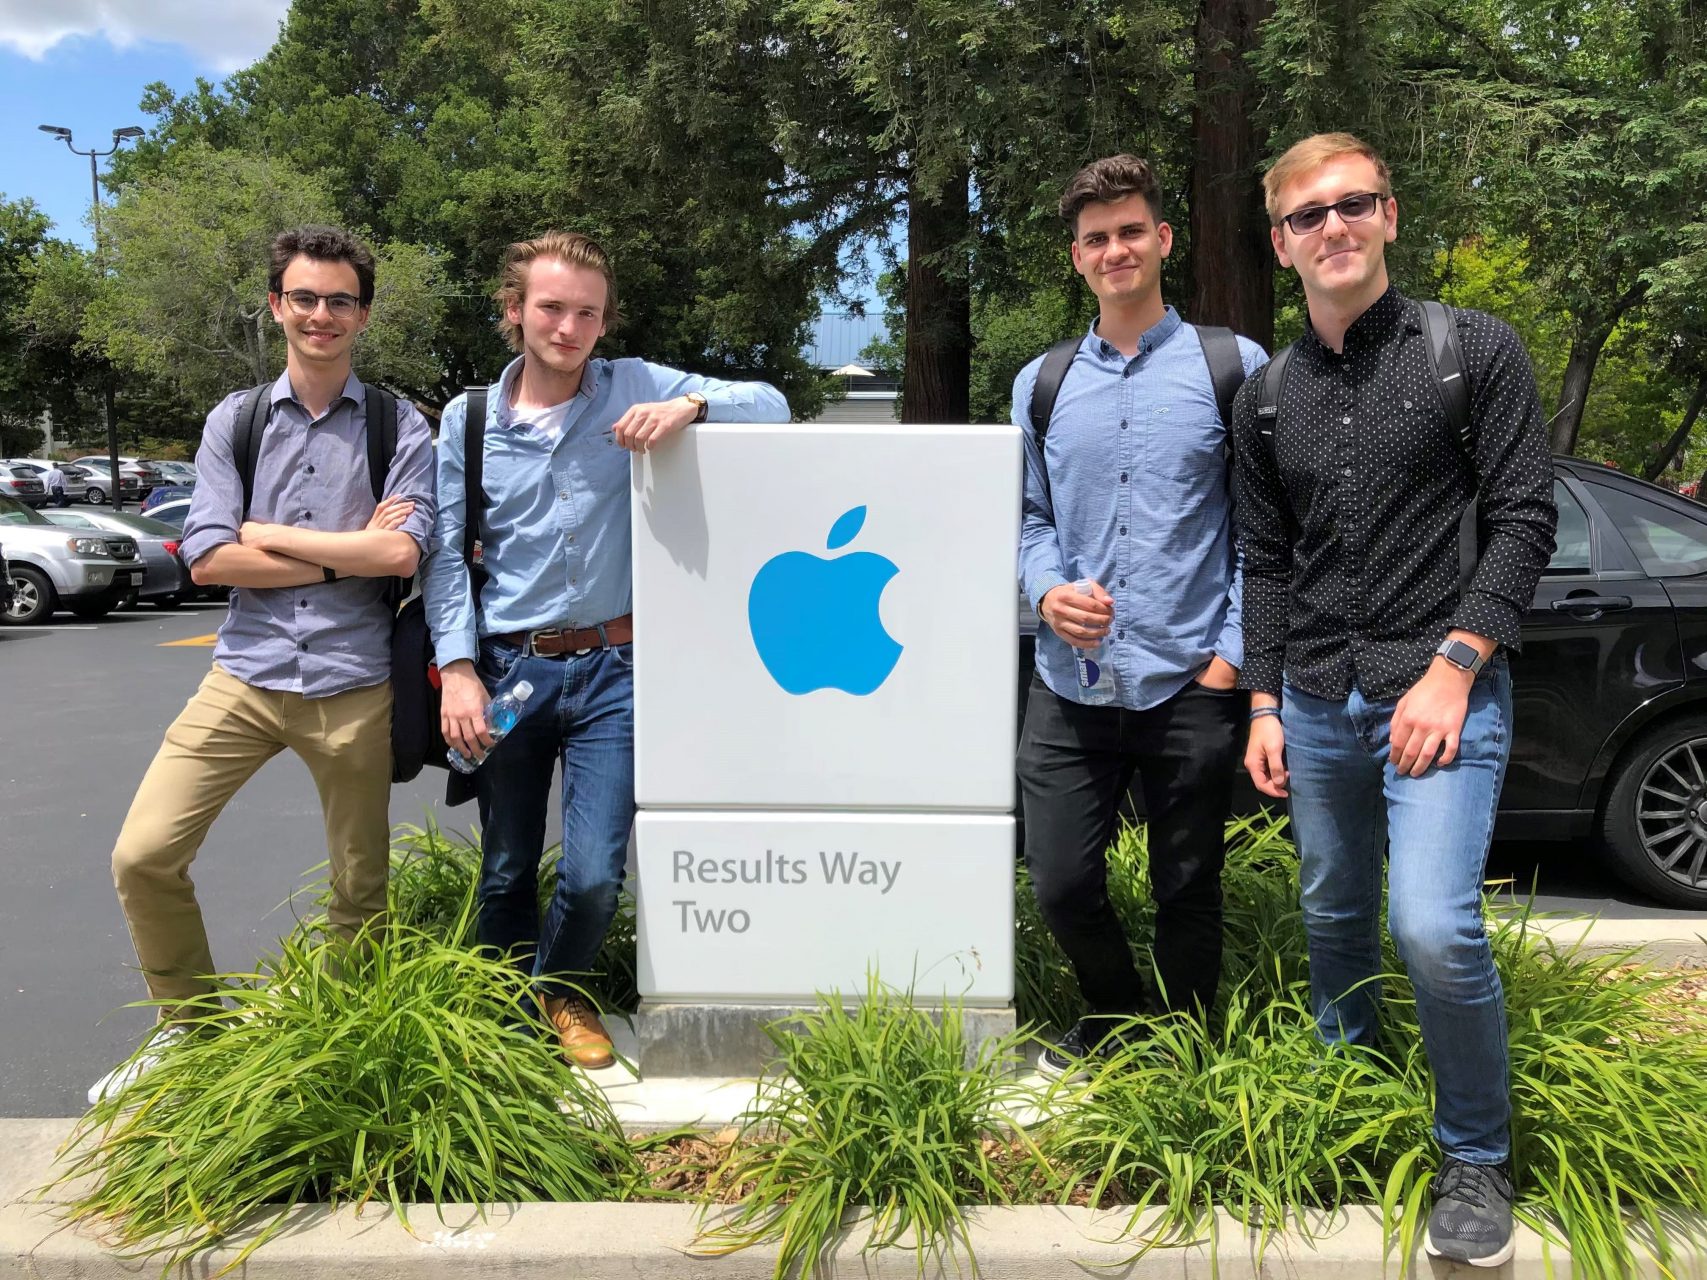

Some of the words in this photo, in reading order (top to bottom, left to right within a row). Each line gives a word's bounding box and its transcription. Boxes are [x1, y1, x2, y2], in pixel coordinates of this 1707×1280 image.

[673, 850, 807, 884] Results
[819, 852, 902, 895] Way
[672, 900, 751, 933] Two
